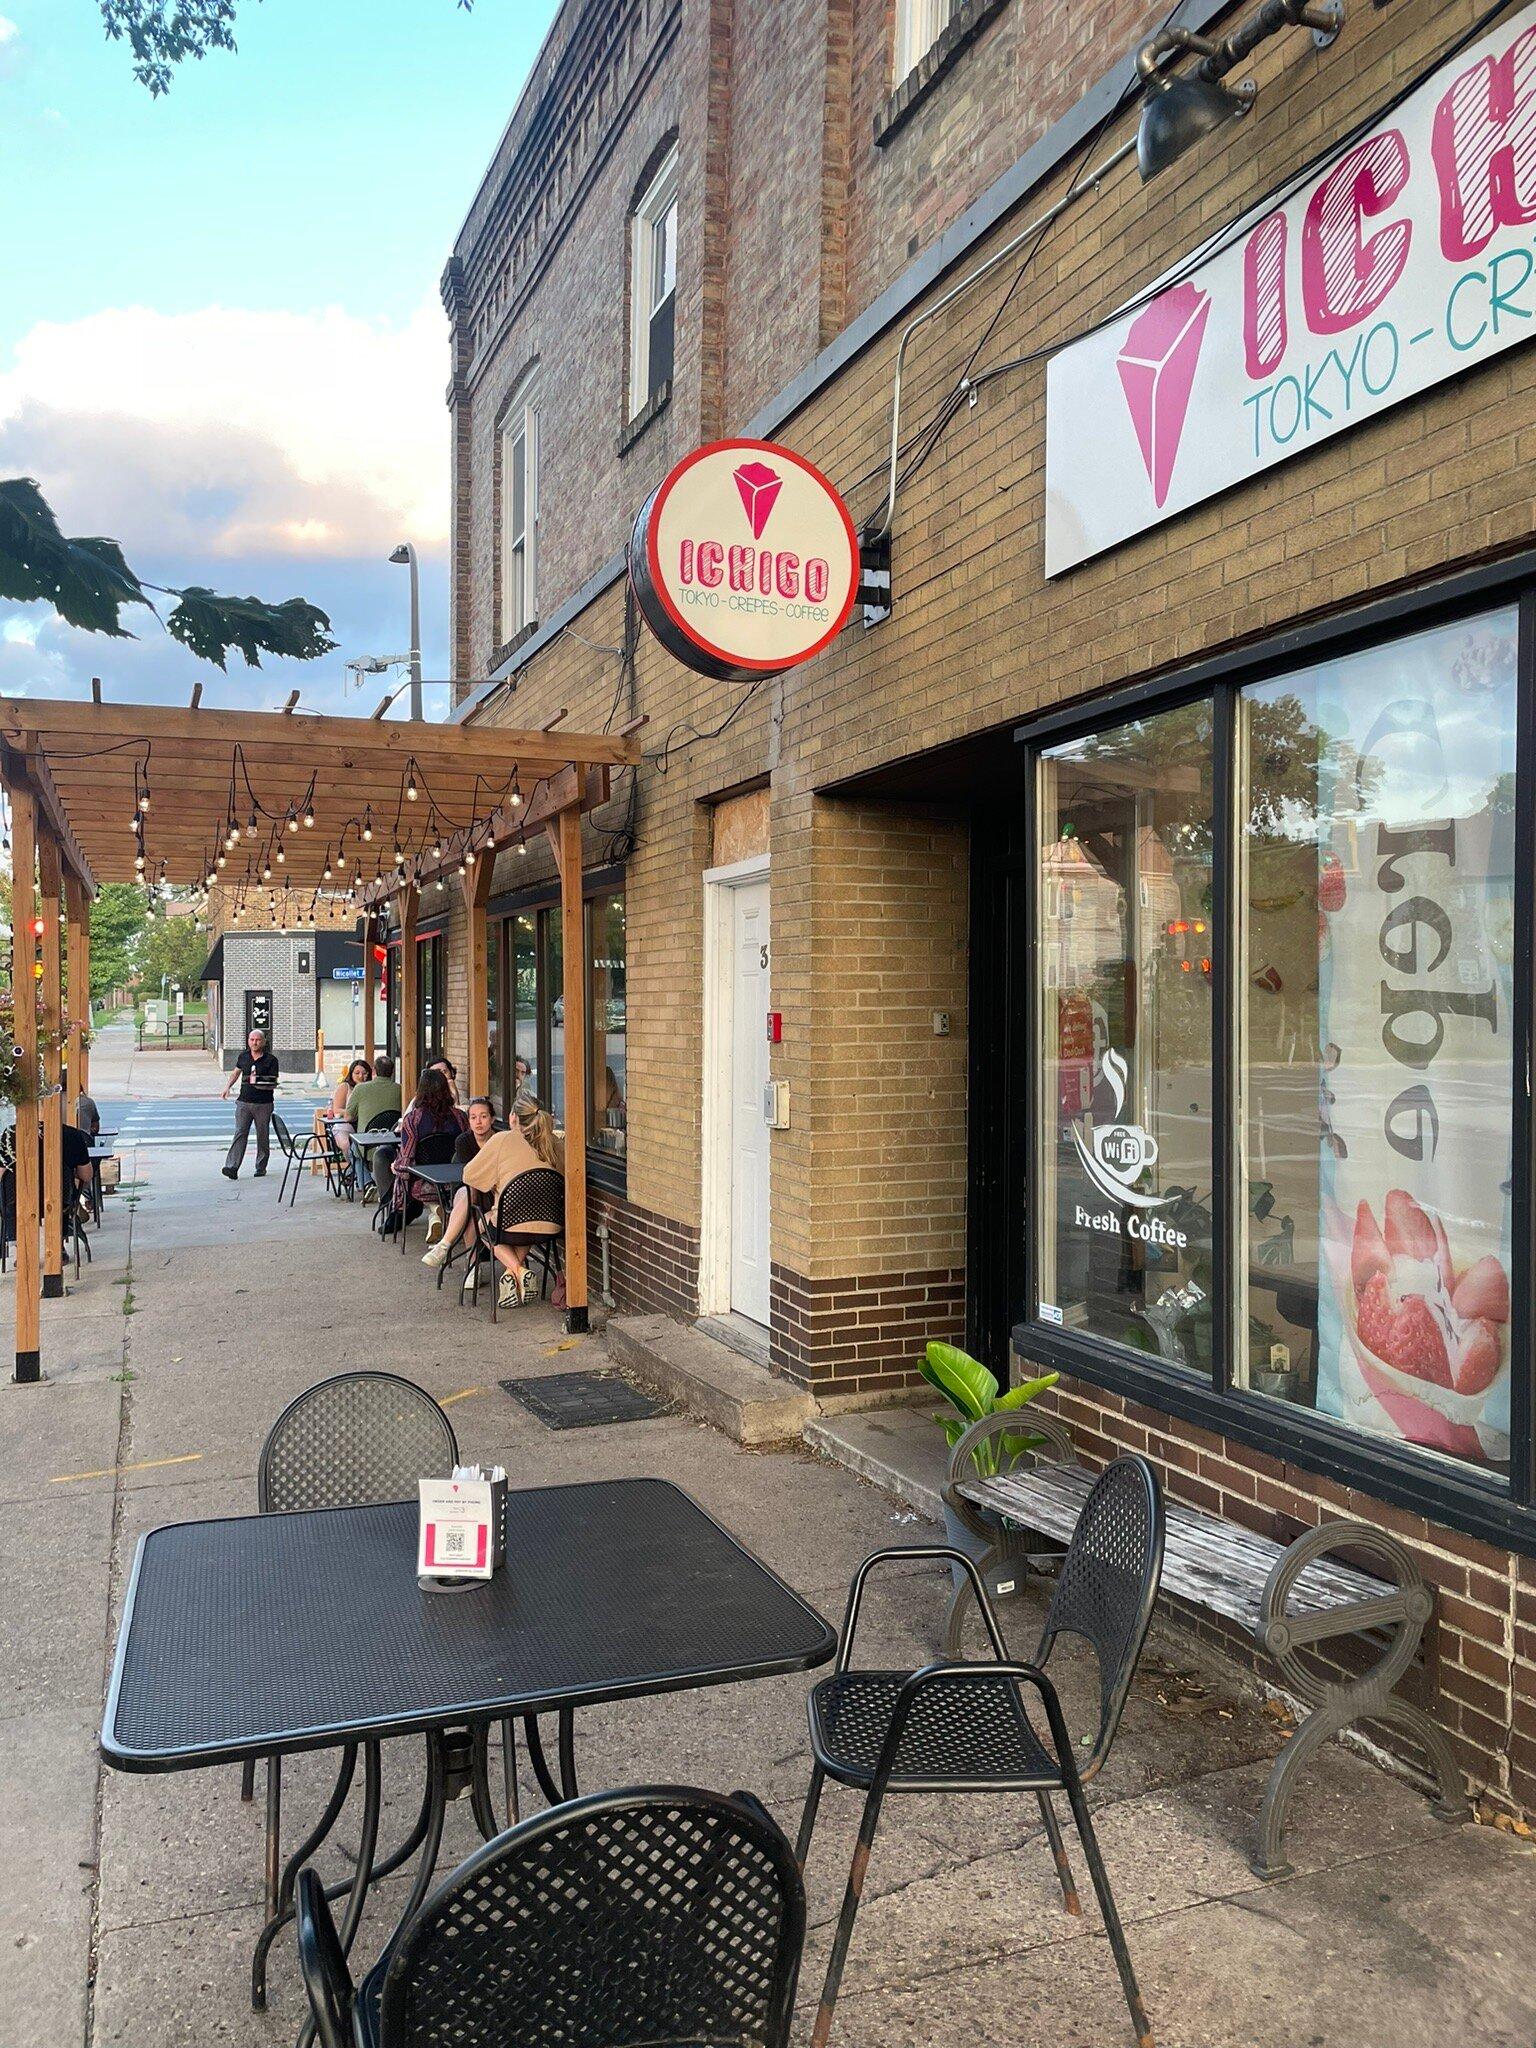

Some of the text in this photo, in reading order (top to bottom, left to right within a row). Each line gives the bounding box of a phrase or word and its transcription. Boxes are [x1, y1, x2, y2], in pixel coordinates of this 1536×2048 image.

[680, 539, 829, 603] ICHIGO
[335, 969, 360, 978] Nicollet
[1075, 1205, 1187, 1247] Fresh Coffee
